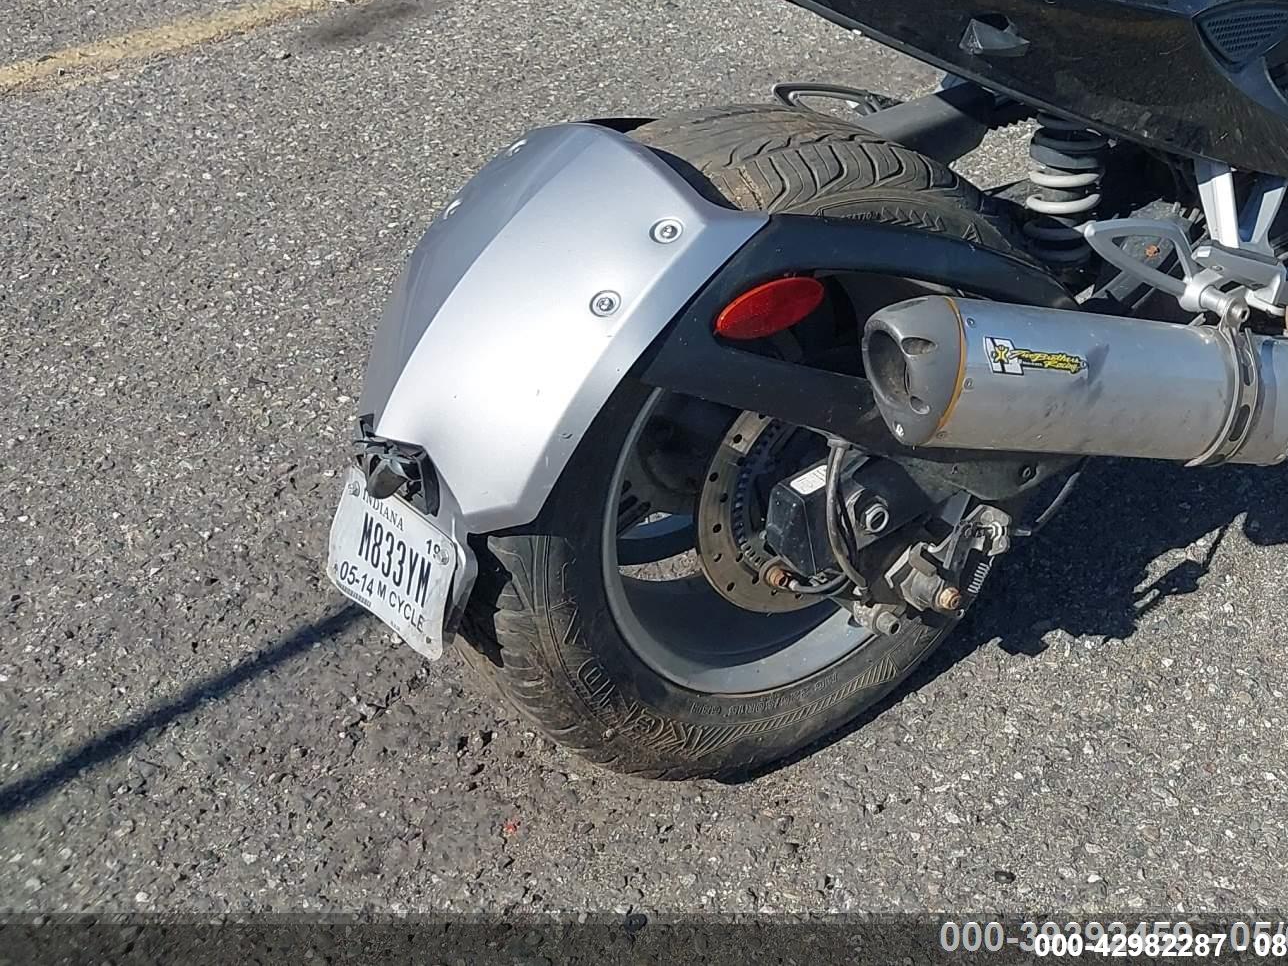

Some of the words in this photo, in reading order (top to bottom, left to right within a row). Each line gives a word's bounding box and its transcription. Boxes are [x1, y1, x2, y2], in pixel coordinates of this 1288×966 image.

[361, 487, 405, 532] INDIANA
[339, 560, 374, 596] 05-14
[388, 590, 424, 635] CYCLE
[358, 511, 432, 609] M833YM
